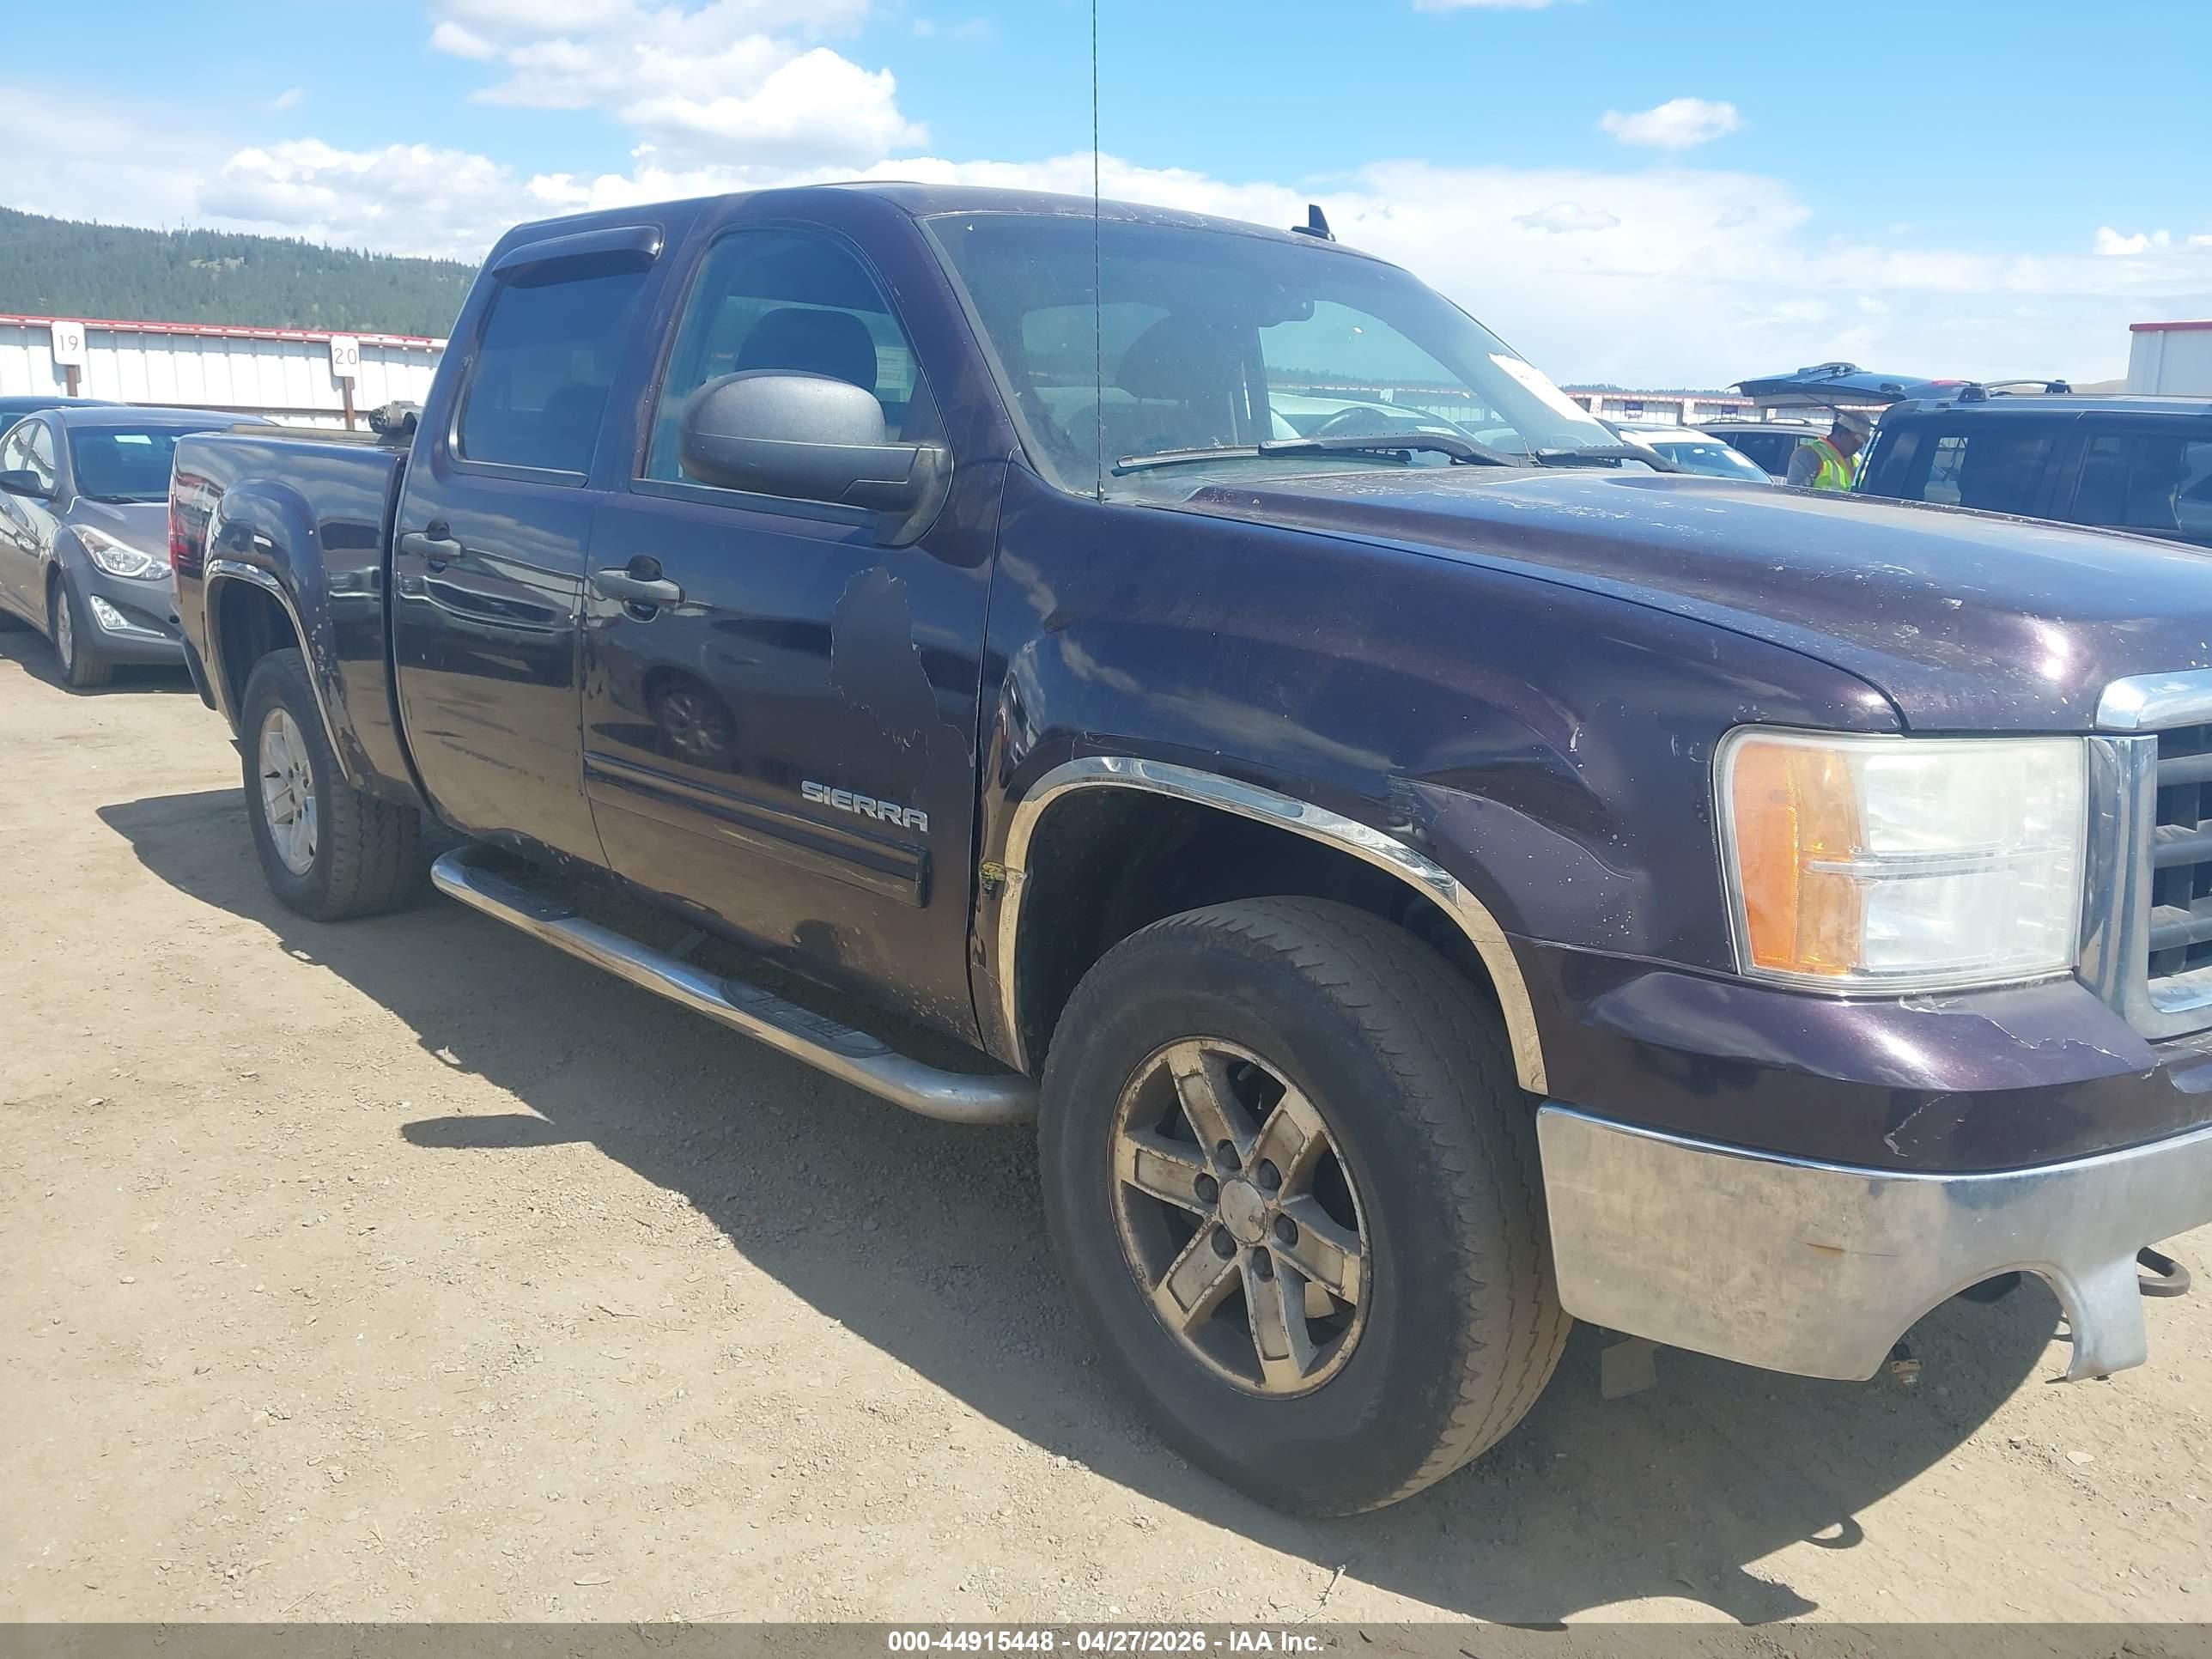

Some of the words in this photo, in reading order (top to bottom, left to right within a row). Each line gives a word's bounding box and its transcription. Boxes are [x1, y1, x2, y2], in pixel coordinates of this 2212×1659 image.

[59, 334, 78, 351] 19
[334, 348, 357, 365] 20
[800, 780, 929, 833] SIERRA
